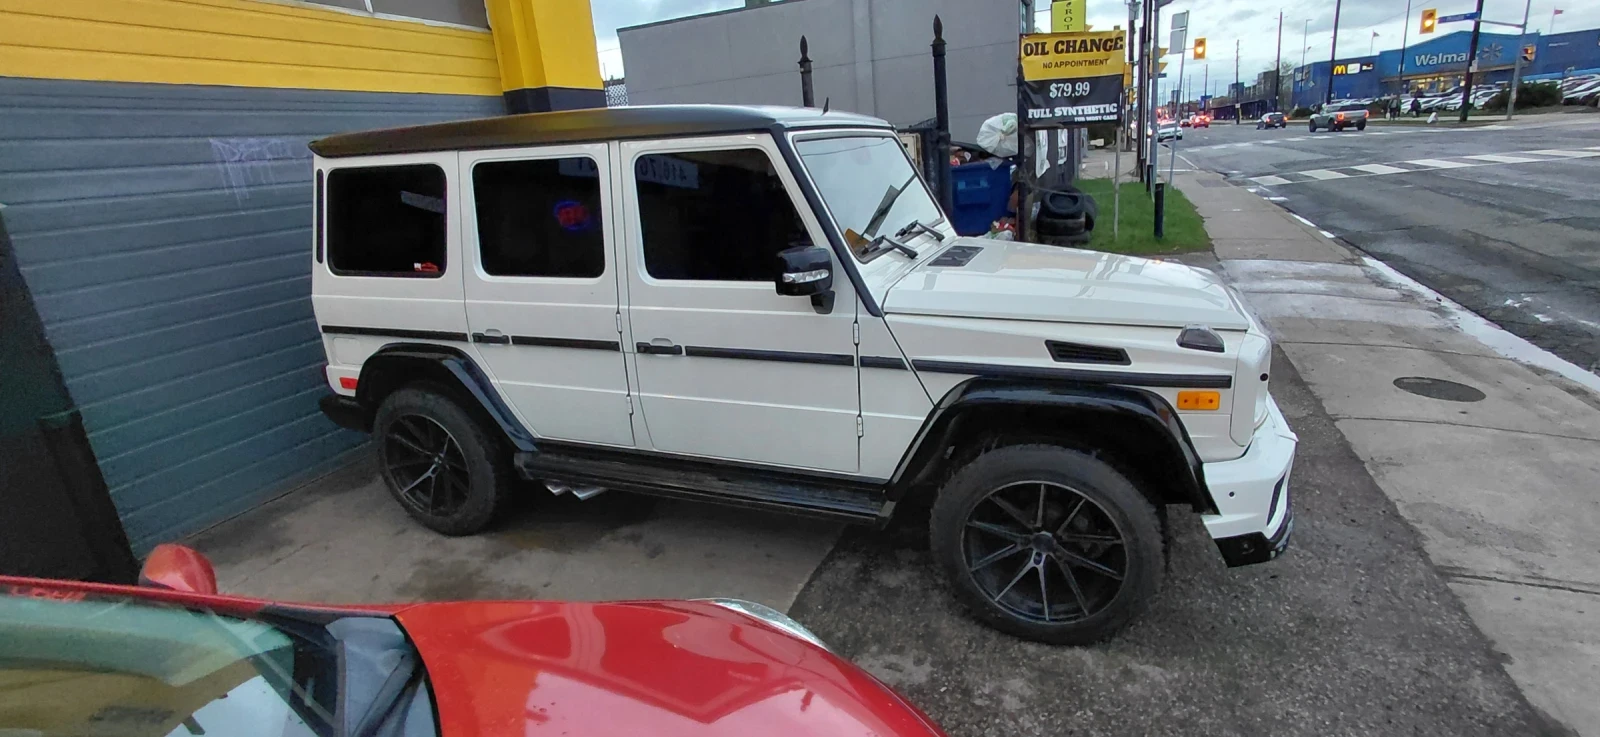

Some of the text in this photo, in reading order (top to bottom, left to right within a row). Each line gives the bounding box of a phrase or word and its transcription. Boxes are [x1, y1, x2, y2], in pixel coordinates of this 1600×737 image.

[1023, 36, 1124, 57] OIL CHANGE
[1054, 58, 1110, 69] APPOINTMENT
[1028, 103, 1118, 119] FULL SYNTHETIC
